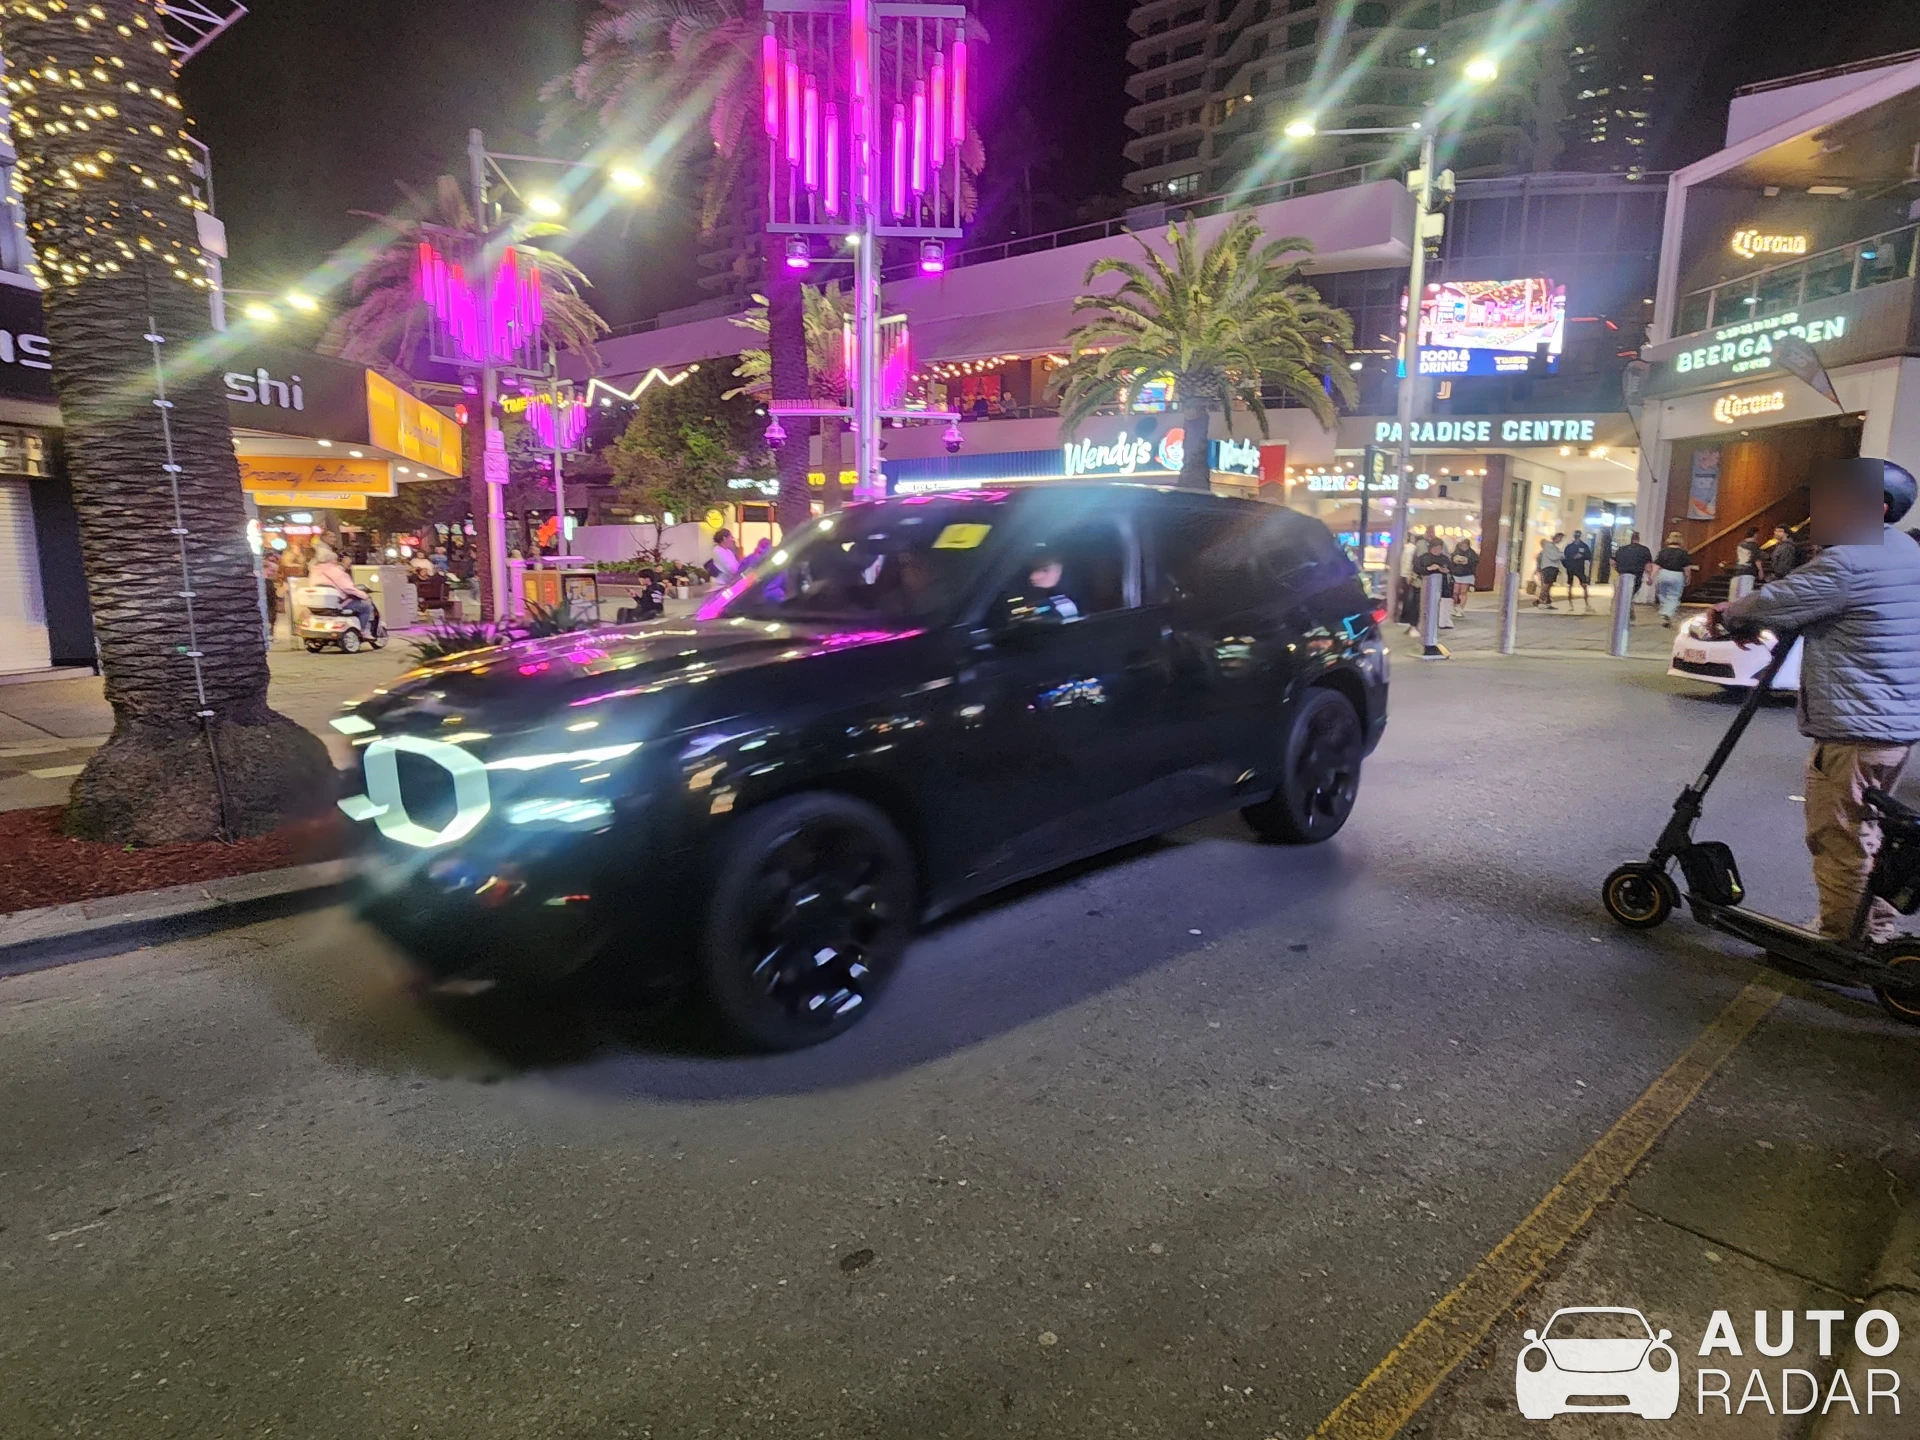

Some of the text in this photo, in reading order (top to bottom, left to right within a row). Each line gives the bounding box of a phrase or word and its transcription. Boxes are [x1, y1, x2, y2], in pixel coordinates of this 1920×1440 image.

[1732, 229, 1806, 259] Corona
[1419, 361, 1468, 374] DRINKS
[1420, 349, 1471, 362] FOOD &
[222, 367, 304, 411] shi
[1713, 390, 1785, 425] Corona
[1501, 419, 1596, 442] CENTRE
[1064, 431, 1152, 477] Wendy's
